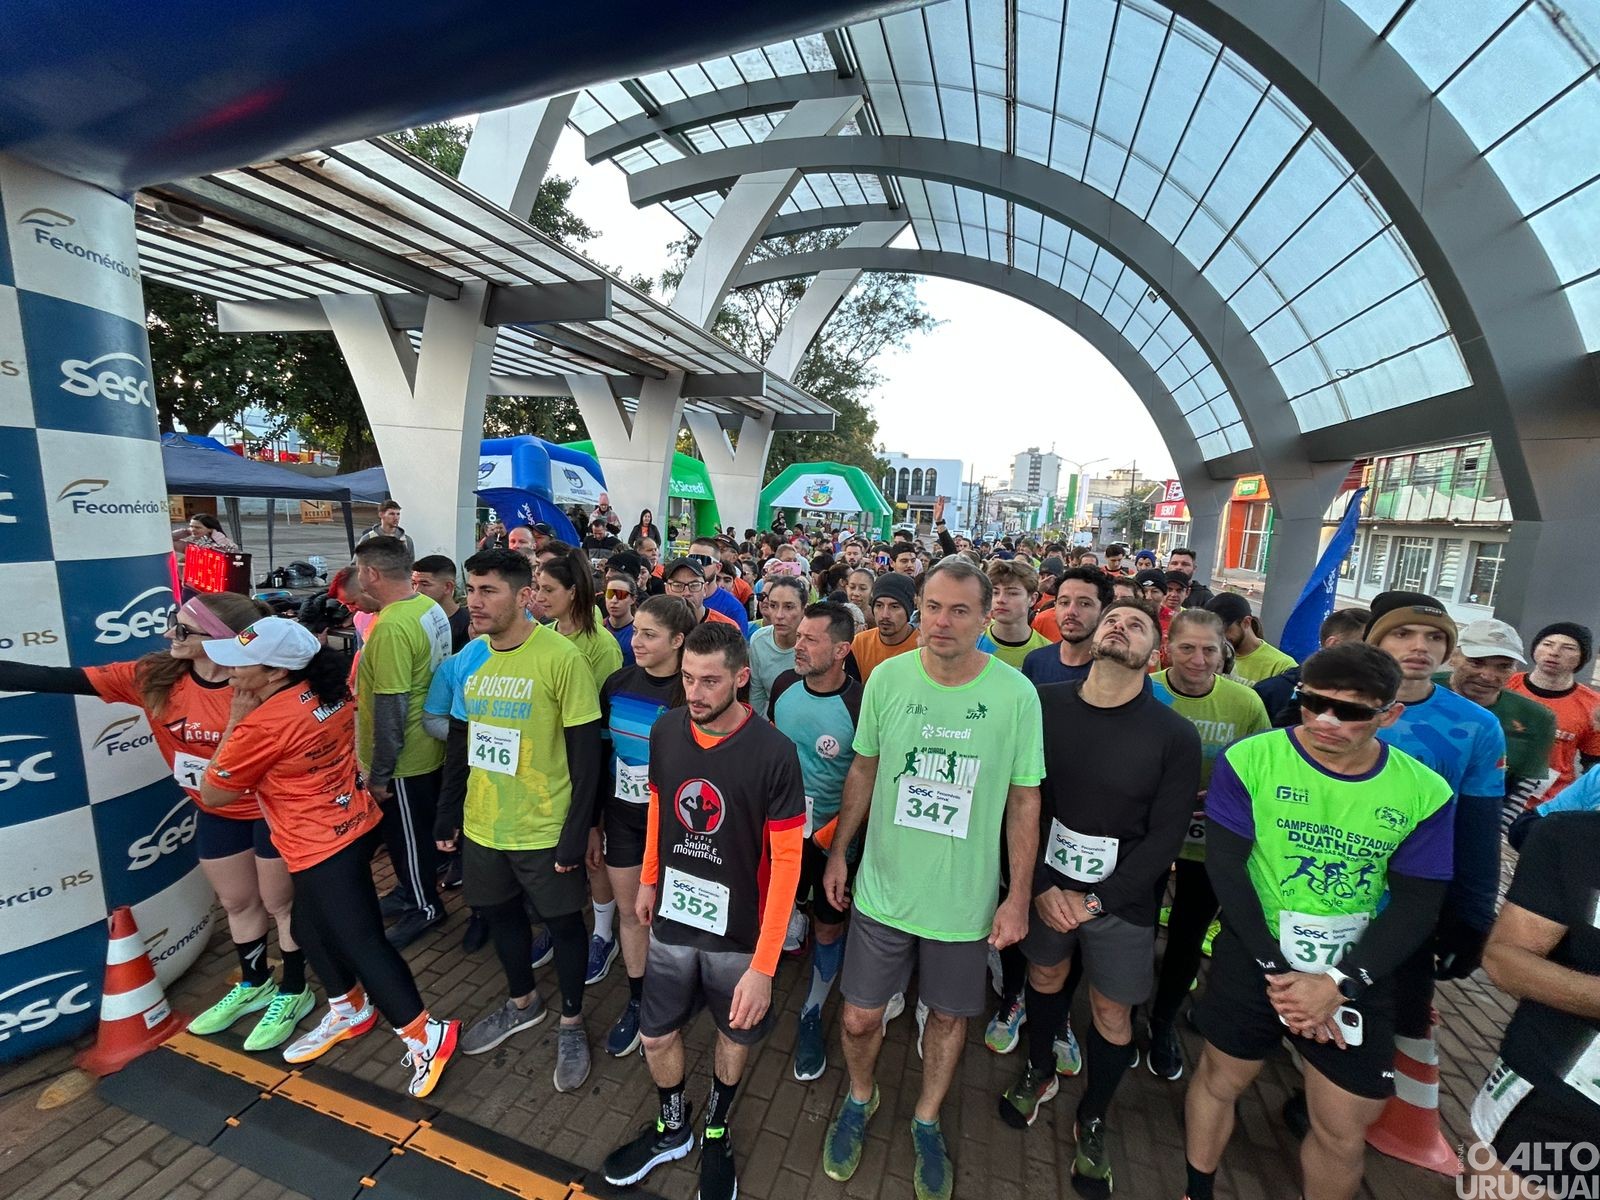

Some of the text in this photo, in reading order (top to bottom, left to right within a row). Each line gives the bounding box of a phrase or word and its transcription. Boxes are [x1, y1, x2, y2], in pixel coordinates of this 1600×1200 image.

[34, 228, 130, 278] Fecomércio
[60, 359, 151, 408] Sesc
[72, 500, 159, 514] Fecomércio
[22, 630, 58, 647] RS
[477, 672, 534, 699] RÚSTICA
[492, 700, 533, 719] SEBERI
[935, 727, 972, 740] Sicredi
[476, 744, 511, 765] 416
[908, 785, 934, 798] Sesc
[906, 797, 959, 826] 347
[1276, 818, 1344, 838] CAMPEONATO
[1056, 833, 1078, 851] Sesc
[1288, 830, 1386, 858] DUATHLON
[673, 844, 723, 865] MOVIMENTO
[1054, 847, 1104, 876] 412
[61, 870, 94, 891] RS
[673, 879, 696, 894] Sesc
[671, 891, 718, 922] 352
[151, 914, 209, 967] ecomércio
[1293, 925, 1329, 940] Sesc
